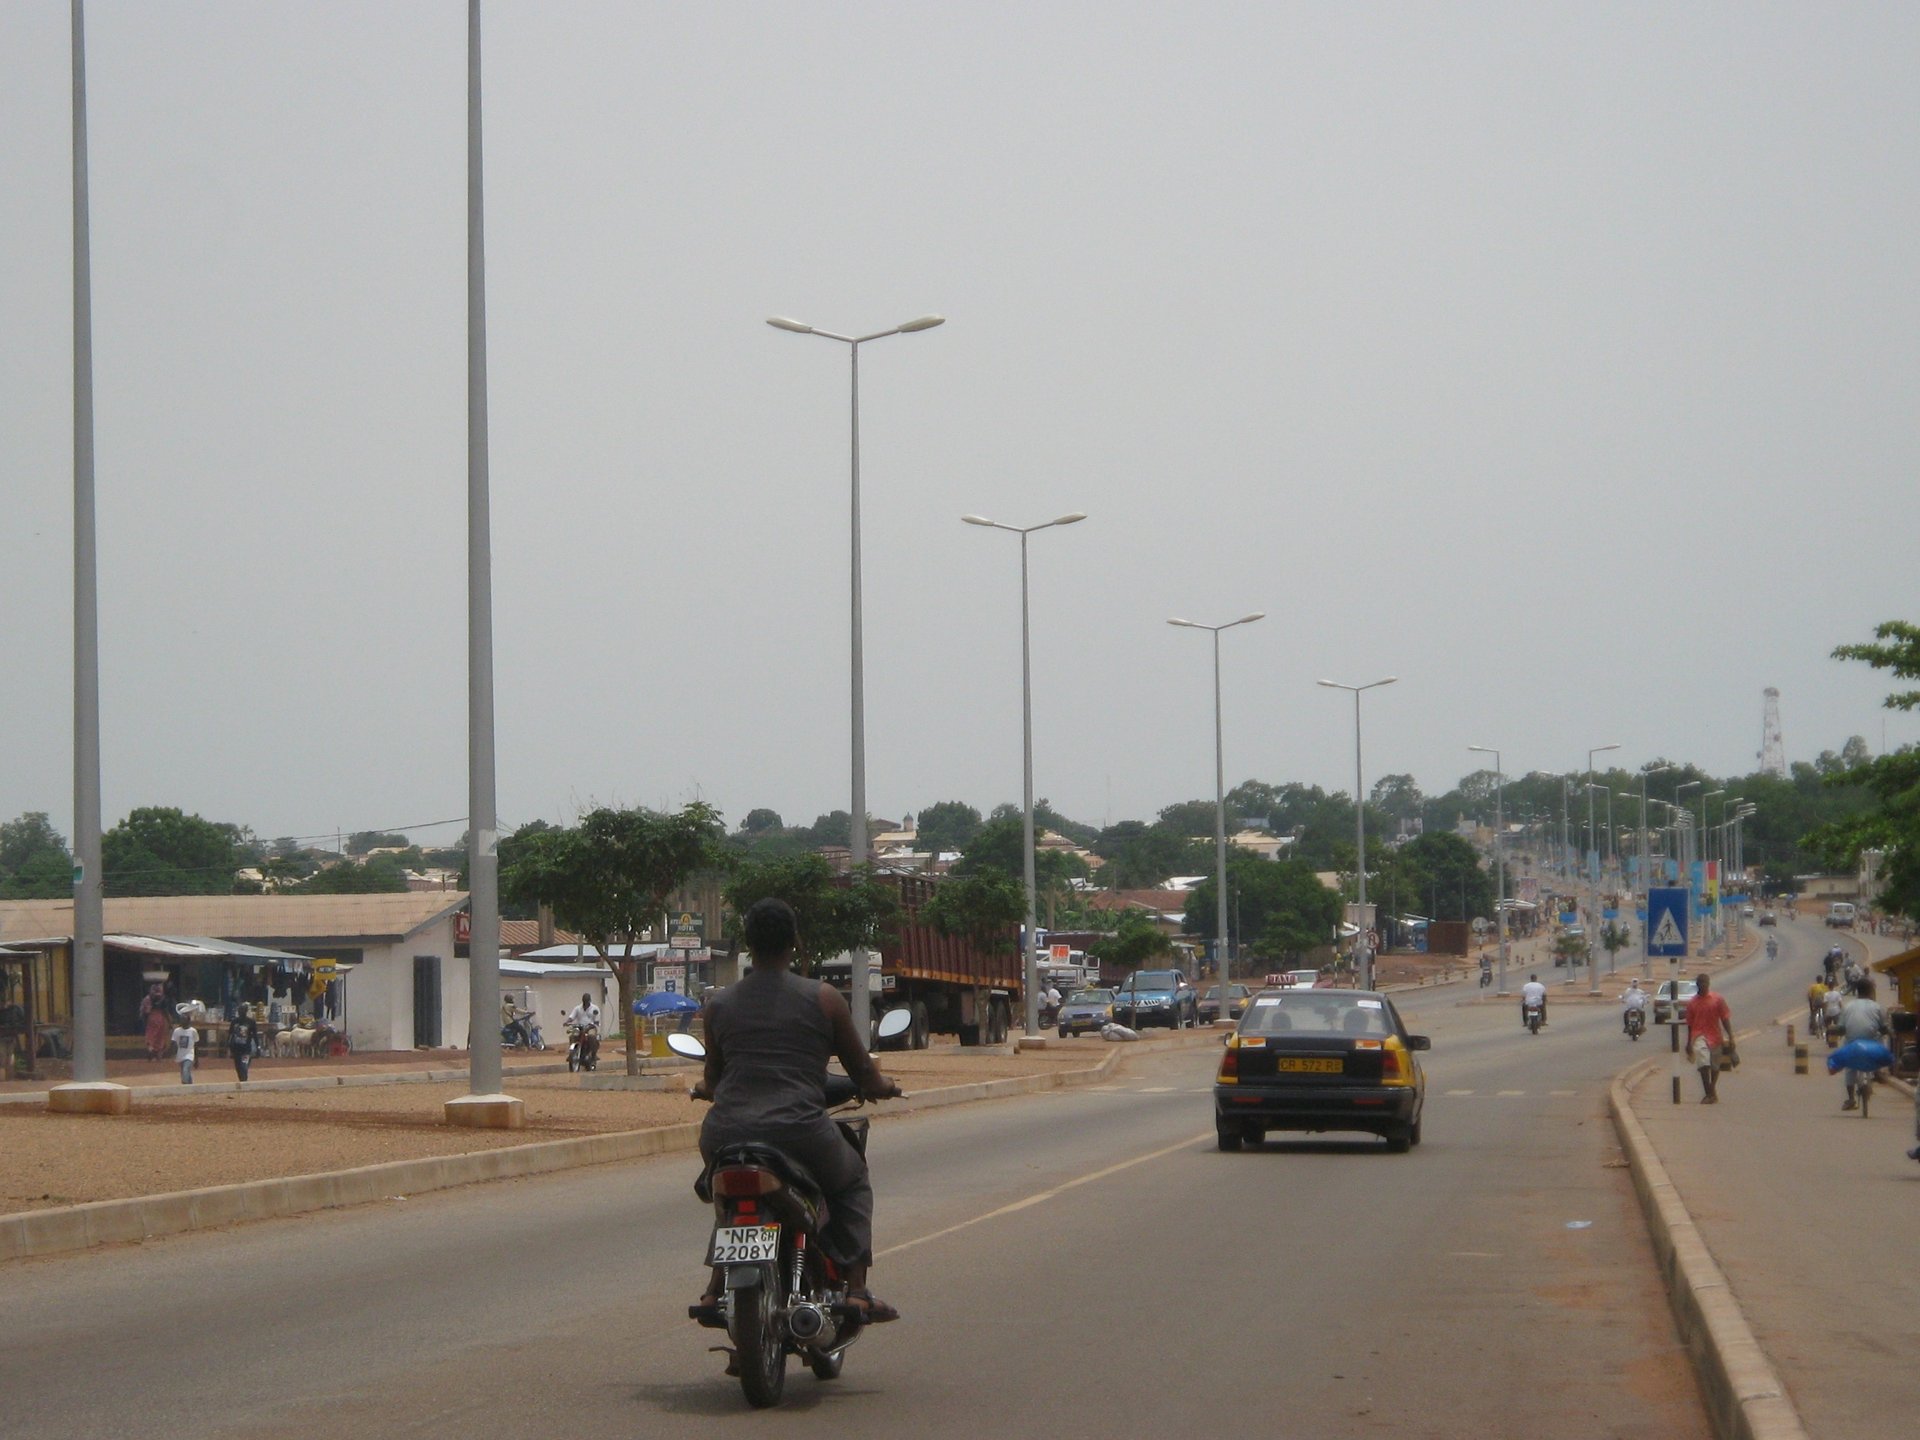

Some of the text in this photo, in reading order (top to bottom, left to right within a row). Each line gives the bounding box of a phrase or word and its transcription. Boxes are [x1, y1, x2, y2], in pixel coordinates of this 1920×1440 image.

[1273, 974, 1291, 983] TAXI
[1302, 1060, 1322, 1072] 572
[731, 1228, 775, 1244] NR GH
[714, 1243, 774, 1261] 2208Y
